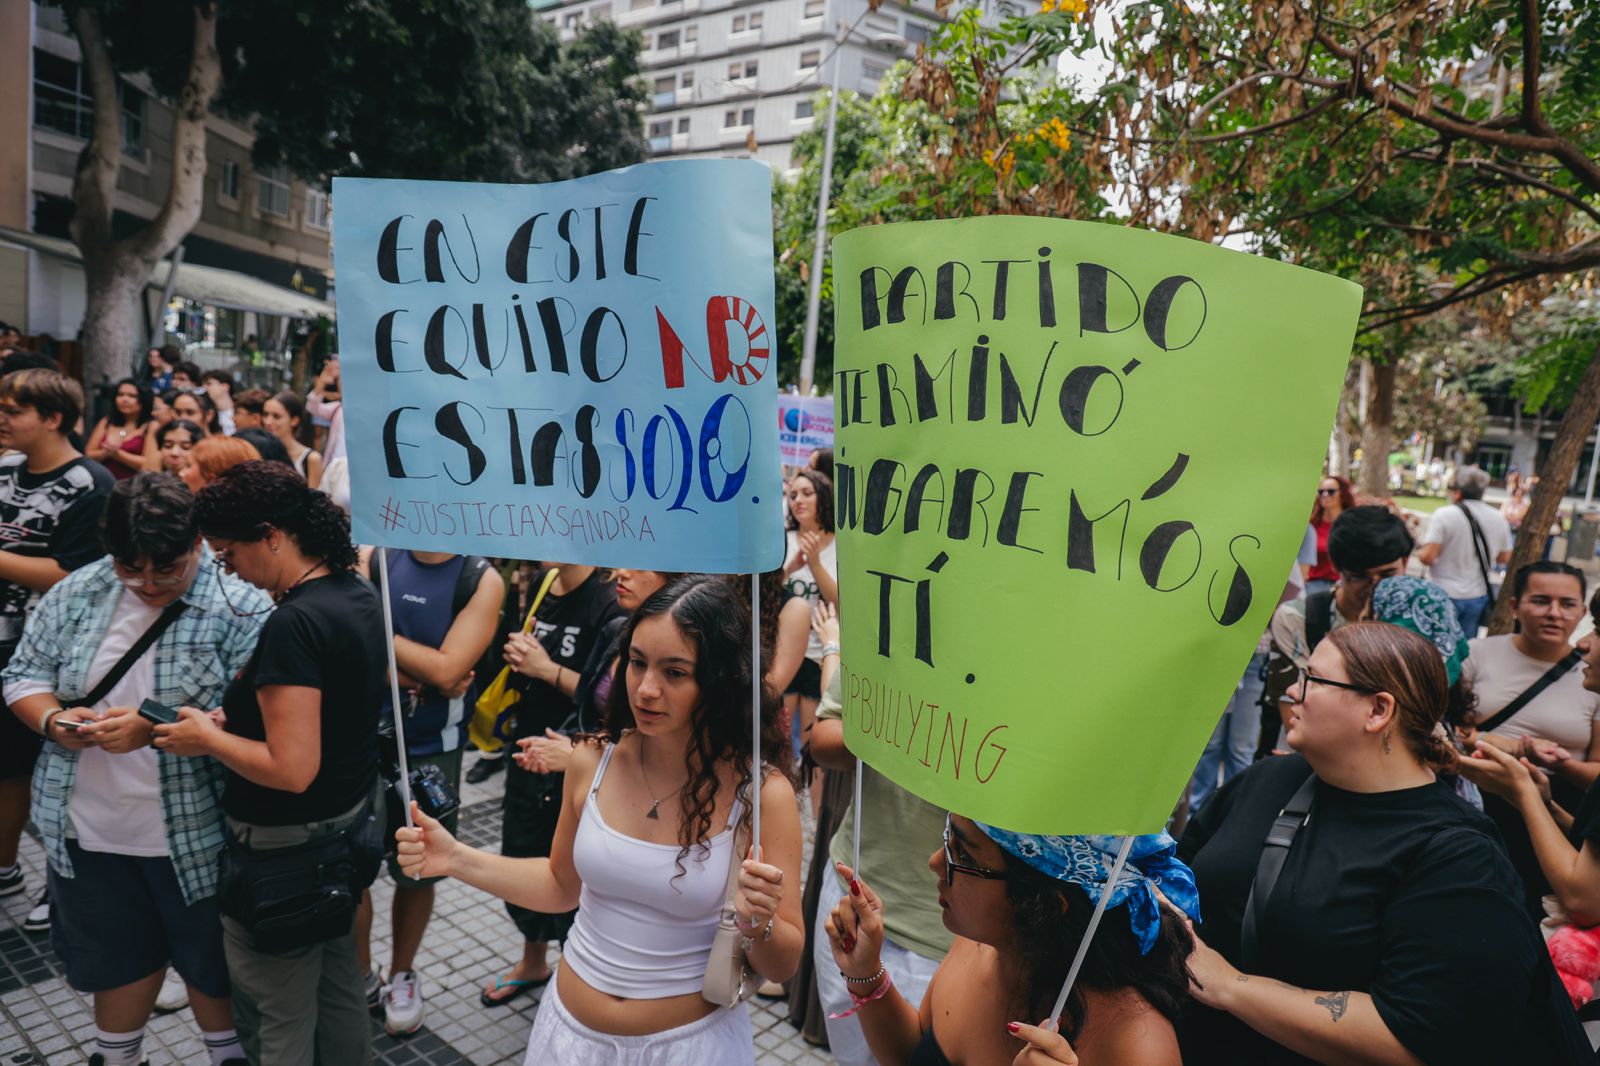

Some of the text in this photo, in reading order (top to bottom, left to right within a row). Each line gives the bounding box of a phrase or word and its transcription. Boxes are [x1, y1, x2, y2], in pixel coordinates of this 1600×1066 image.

[376, 196, 661, 284] EN ESTE
[655, 295, 770, 389] NO
[382, 400, 601, 499] ESTAS
[378, 496, 656, 545] #JUSTICIAXSANDRA
